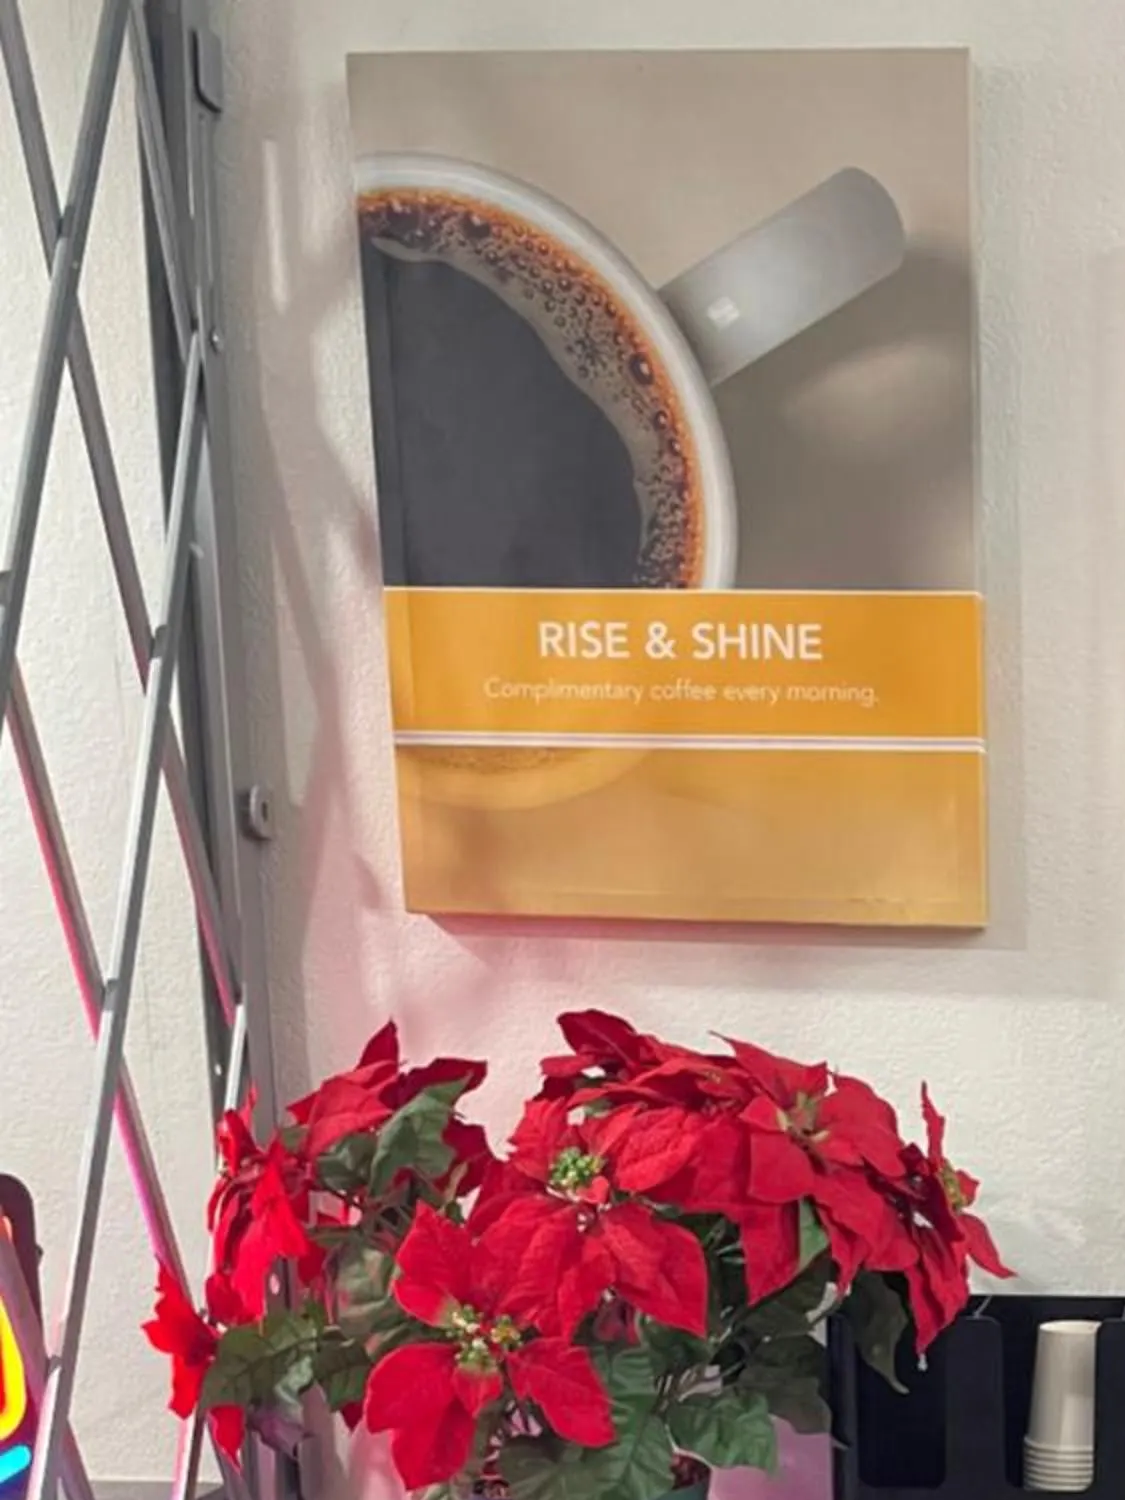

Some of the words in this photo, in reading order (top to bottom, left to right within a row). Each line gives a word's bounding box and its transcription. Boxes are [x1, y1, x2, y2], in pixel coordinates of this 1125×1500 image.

[539, 621, 631, 660] RISE
[645, 622, 677, 661] &
[691, 623, 824, 662] SHINE
[483, 677, 644, 705] Complimentary
[650, 677, 718, 703] coffee
[722, 684, 781, 706] every
[786, 682, 881, 709] morning.
